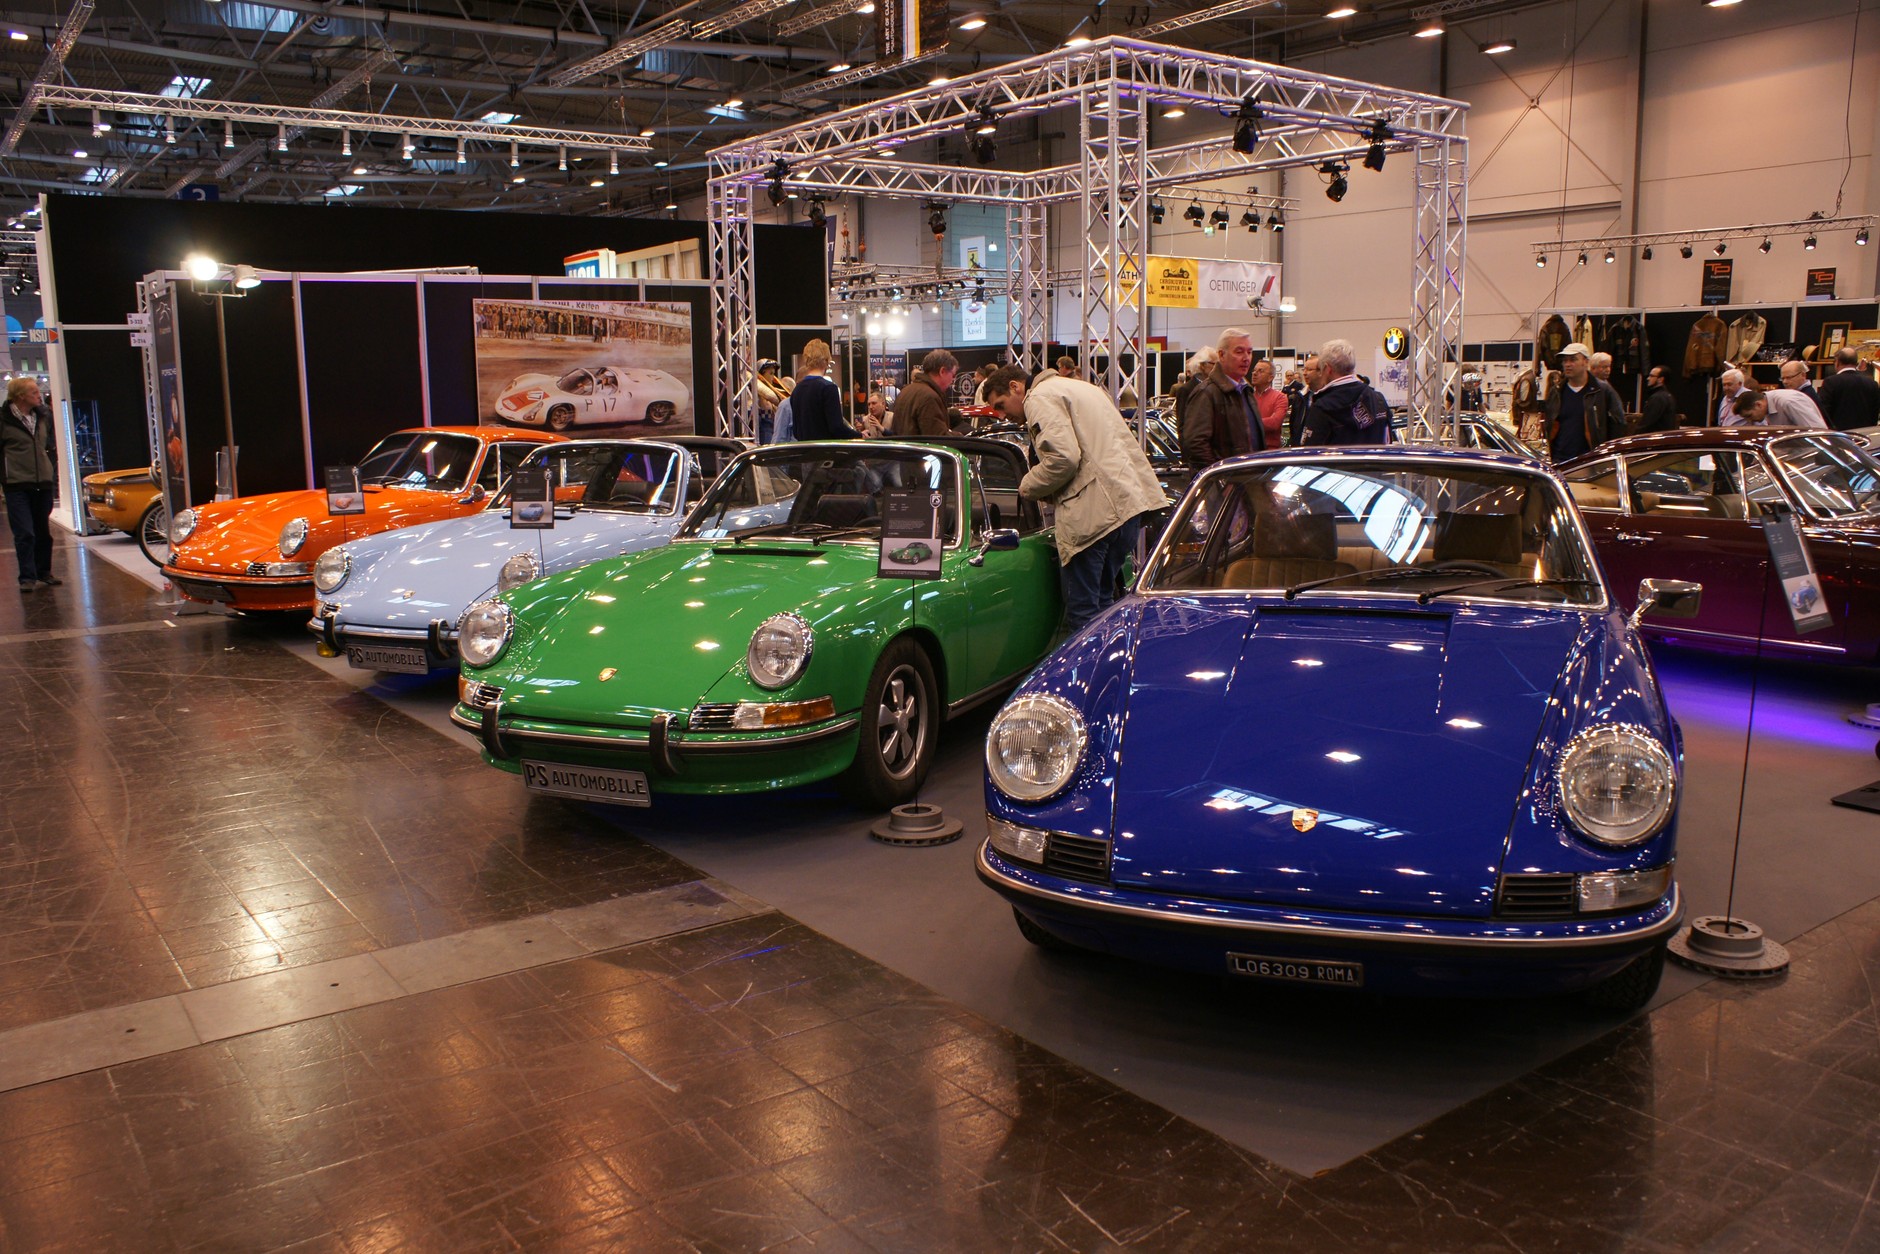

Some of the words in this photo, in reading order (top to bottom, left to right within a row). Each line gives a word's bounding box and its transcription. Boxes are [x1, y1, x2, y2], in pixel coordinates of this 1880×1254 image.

[1705, 263, 1731, 275] TP
[1809, 271, 1834, 283] TP
[1209, 279, 1257, 293] OETTINGER
[29, 329, 48, 343] NSU
[603, 398, 617, 412] 17
[348, 647, 364, 663] PS
[366, 651, 426, 666] AUTOMOBILE
[525, 764, 549, 787] PS
[552, 770, 646, 795] AUTOMOBILE
[1317, 966, 1354, 982] ROMA
